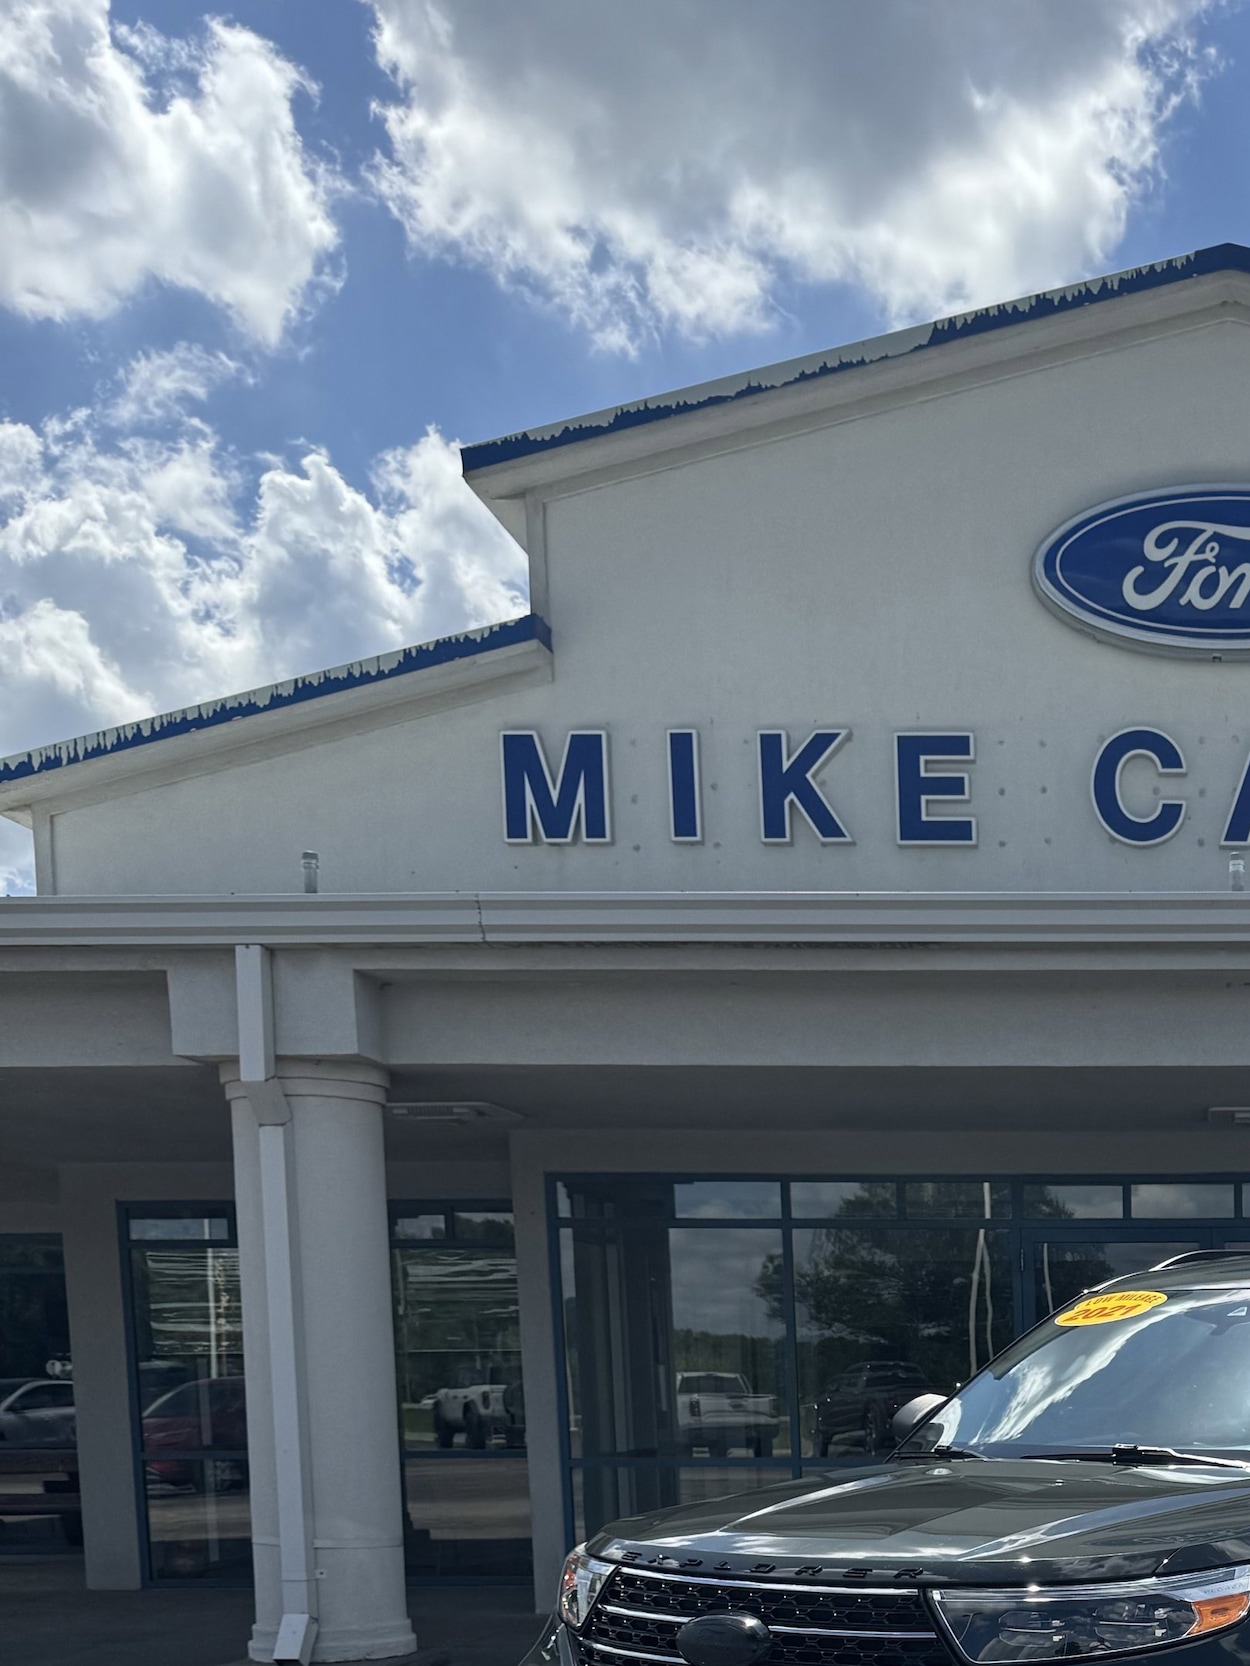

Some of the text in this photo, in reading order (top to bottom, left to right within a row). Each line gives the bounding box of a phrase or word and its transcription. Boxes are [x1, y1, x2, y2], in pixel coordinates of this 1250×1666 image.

[501, 729, 979, 846] MIKE
[1086, 1293, 1163, 1306] LOW MILEAGE
[1062, 1304, 1142, 1322] 2021
[621, 1551, 924, 1579] EXPLORER
